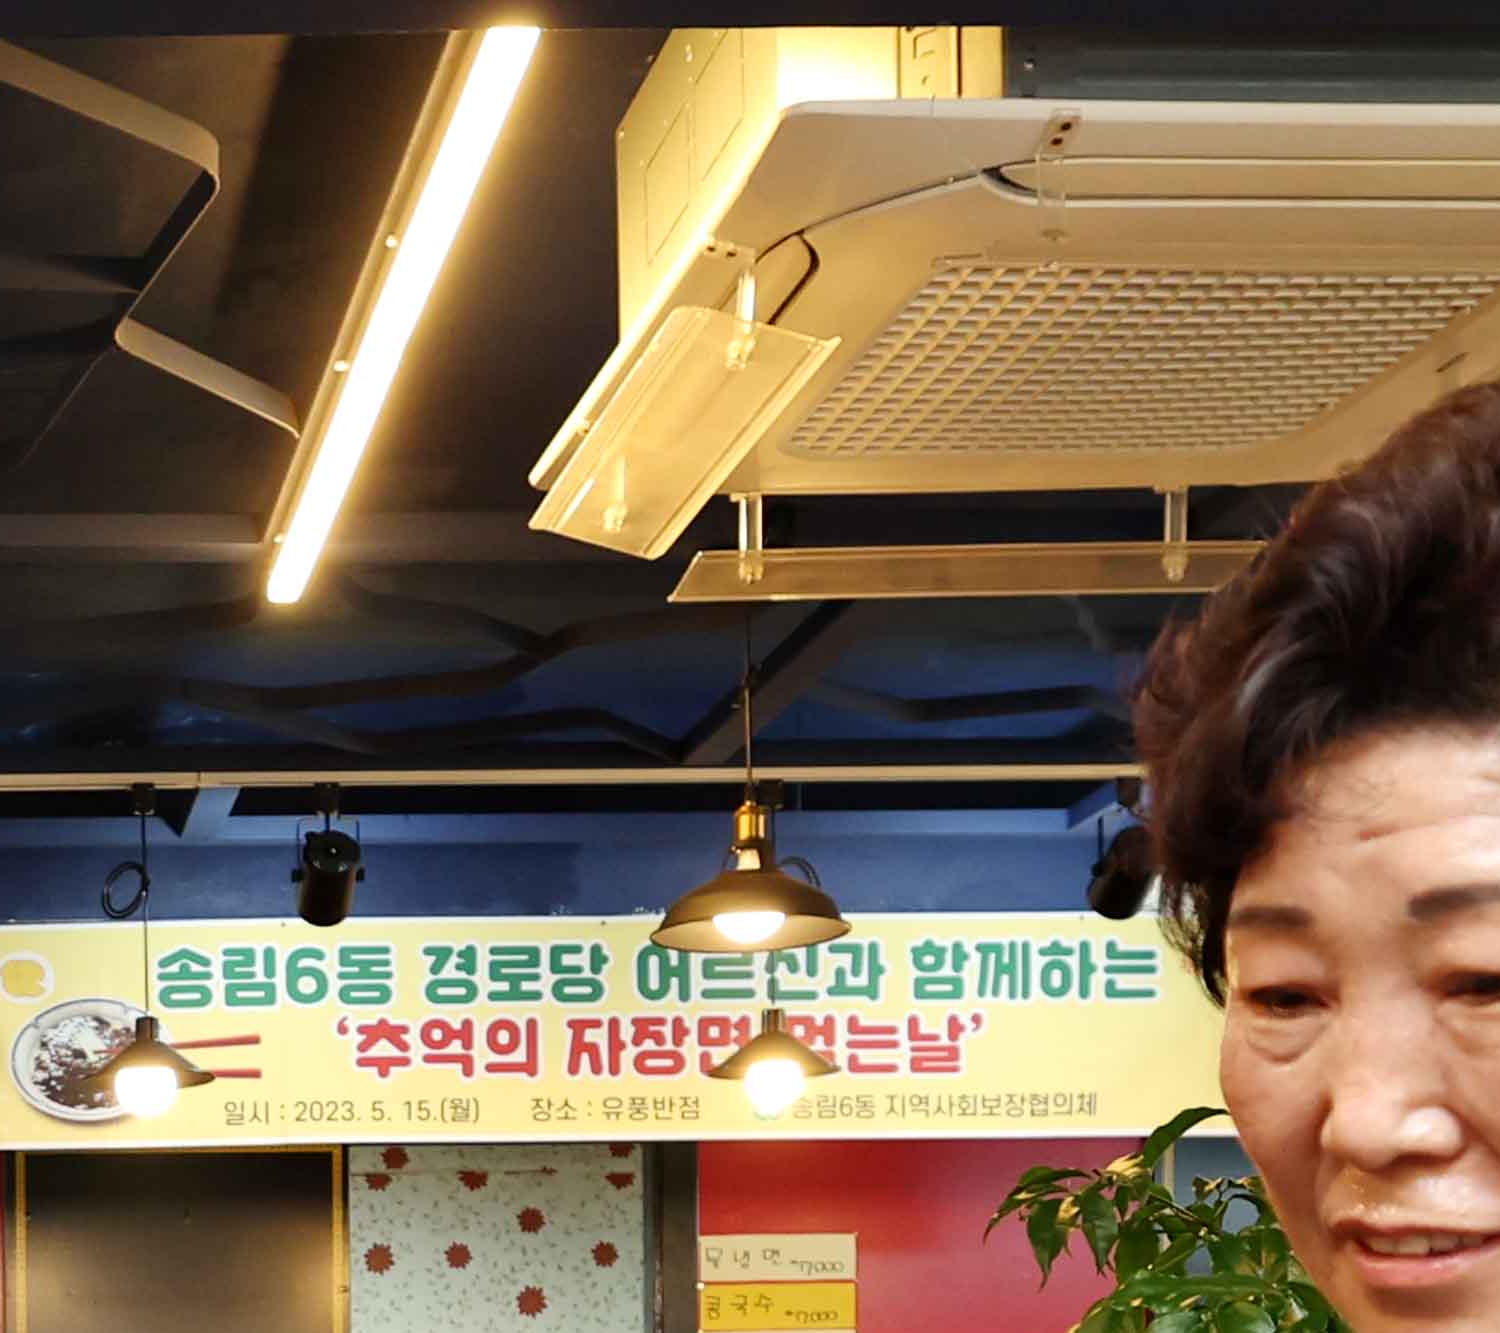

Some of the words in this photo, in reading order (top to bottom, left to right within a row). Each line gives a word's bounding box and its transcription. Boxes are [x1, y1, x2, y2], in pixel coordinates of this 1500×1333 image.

[155, 944, 395, 1009] 송림6동
[422, 942, 609, 1006] 경로당
[636, 940, 886, 1002] 어르신과
[910, 938, 1159, 1002] 함께하는
[223, 1099, 270, 1125] 일시
[293, 1100, 363, 1123] 2023.
[370, 1100, 391, 1123] 5.
[404, 1098, 481, 1125] 15.(월)
[530, 1096, 579, 1122] 장소
[601, 1095, 702, 1122] 유풍반점
[885, 1092, 1098, 1119] 지역사회보장협의체
